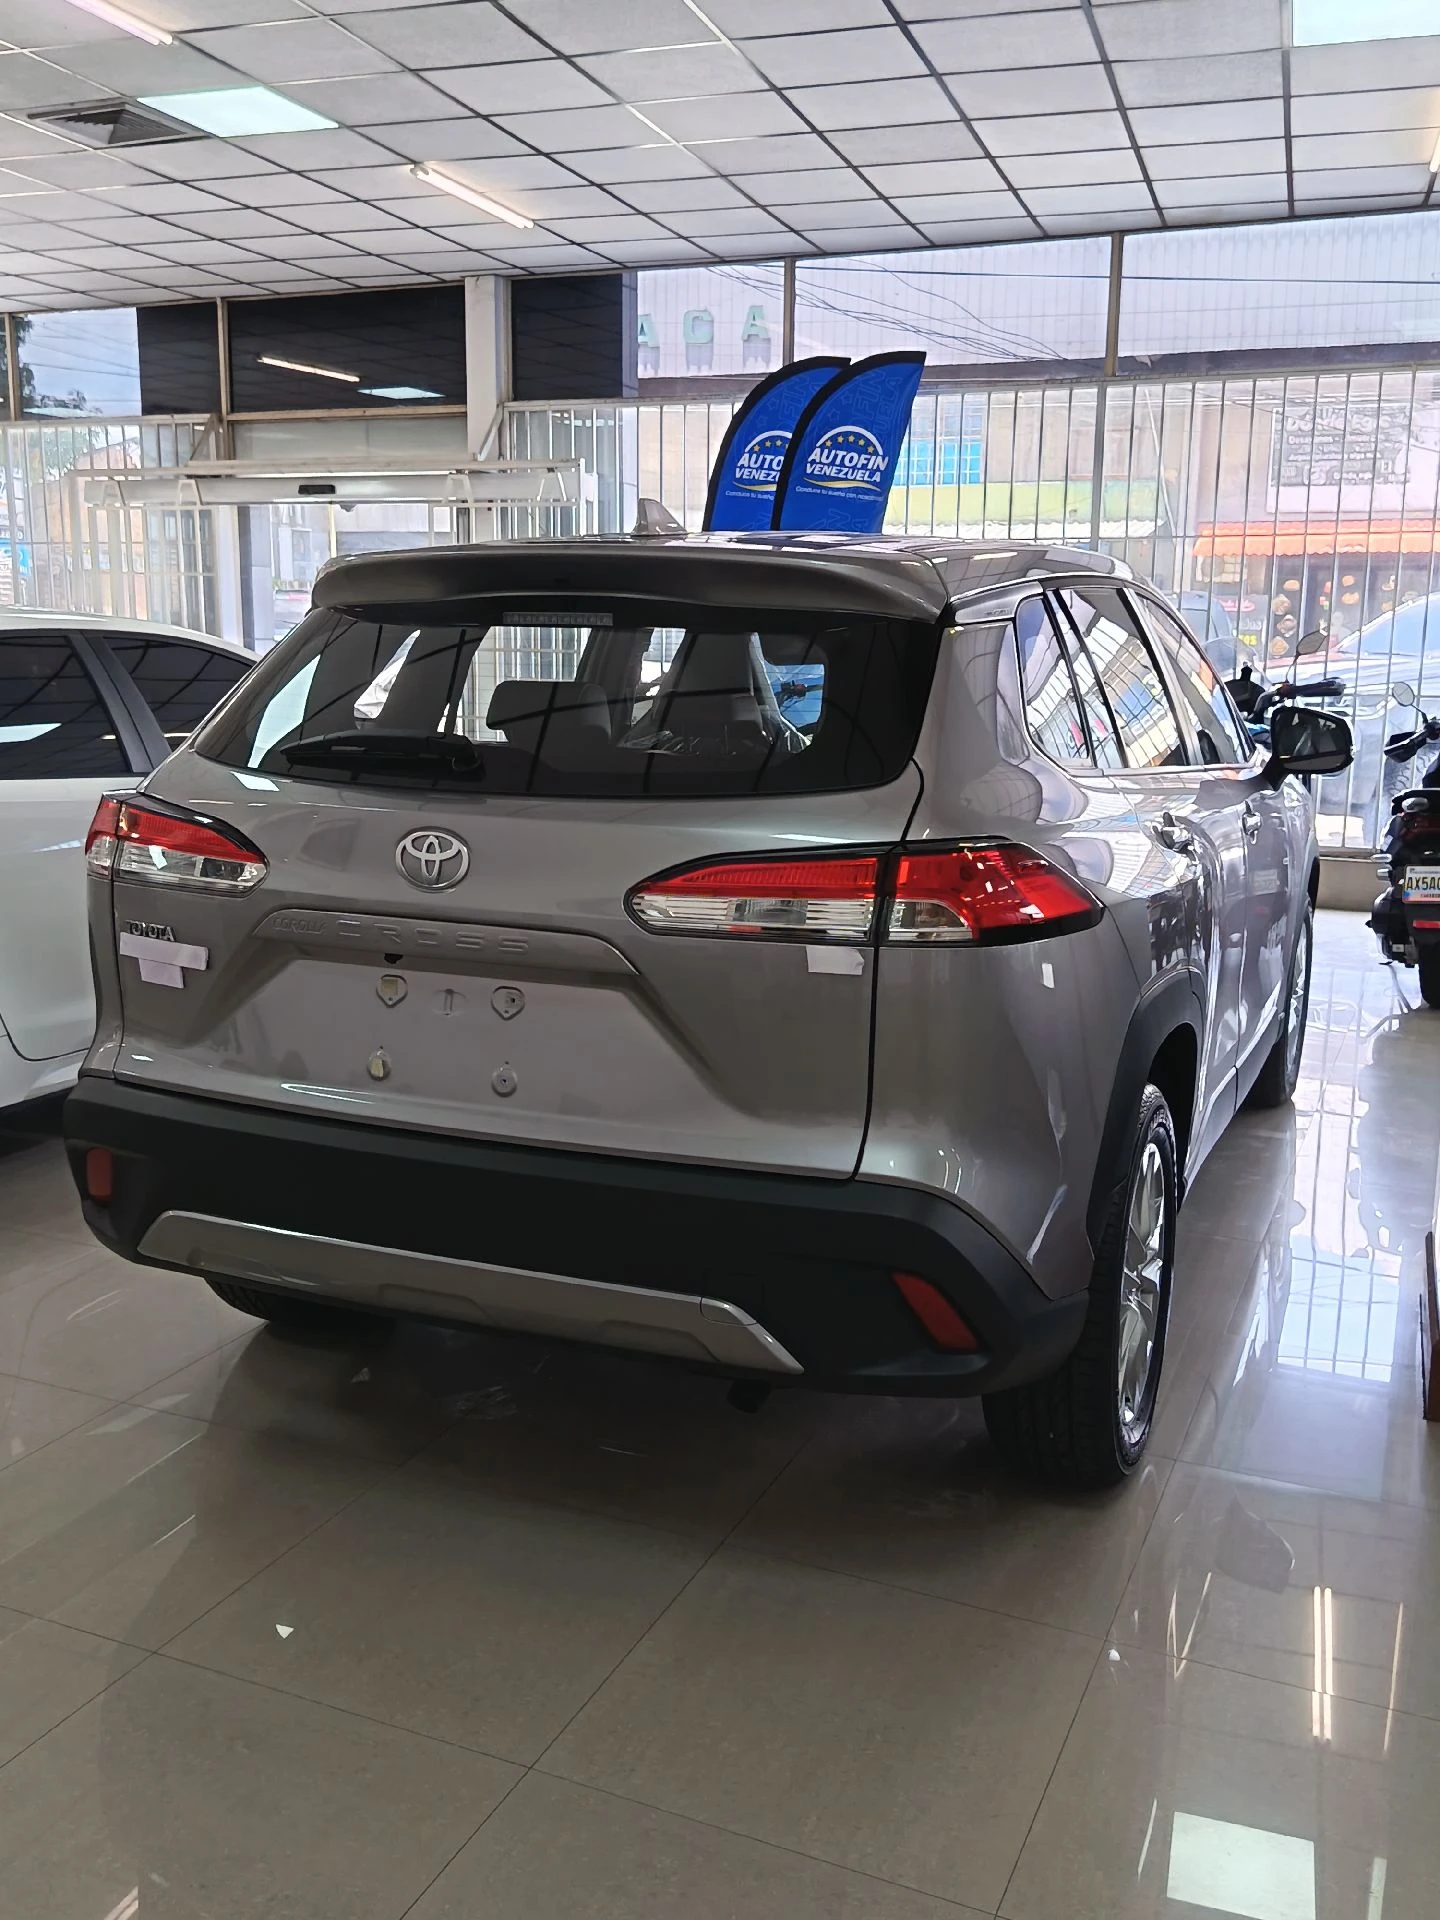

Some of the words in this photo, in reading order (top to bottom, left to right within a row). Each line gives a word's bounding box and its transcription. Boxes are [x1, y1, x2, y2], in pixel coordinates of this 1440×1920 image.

[807, 447, 889, 471] AUTOFIN
[805, 463, 881, 482] VENEZUELA
[125, 919, 176, 942] TOYOTA
[271, 914, 328, 935] COROLLA
[336, 918, 530, 952] CROSS
